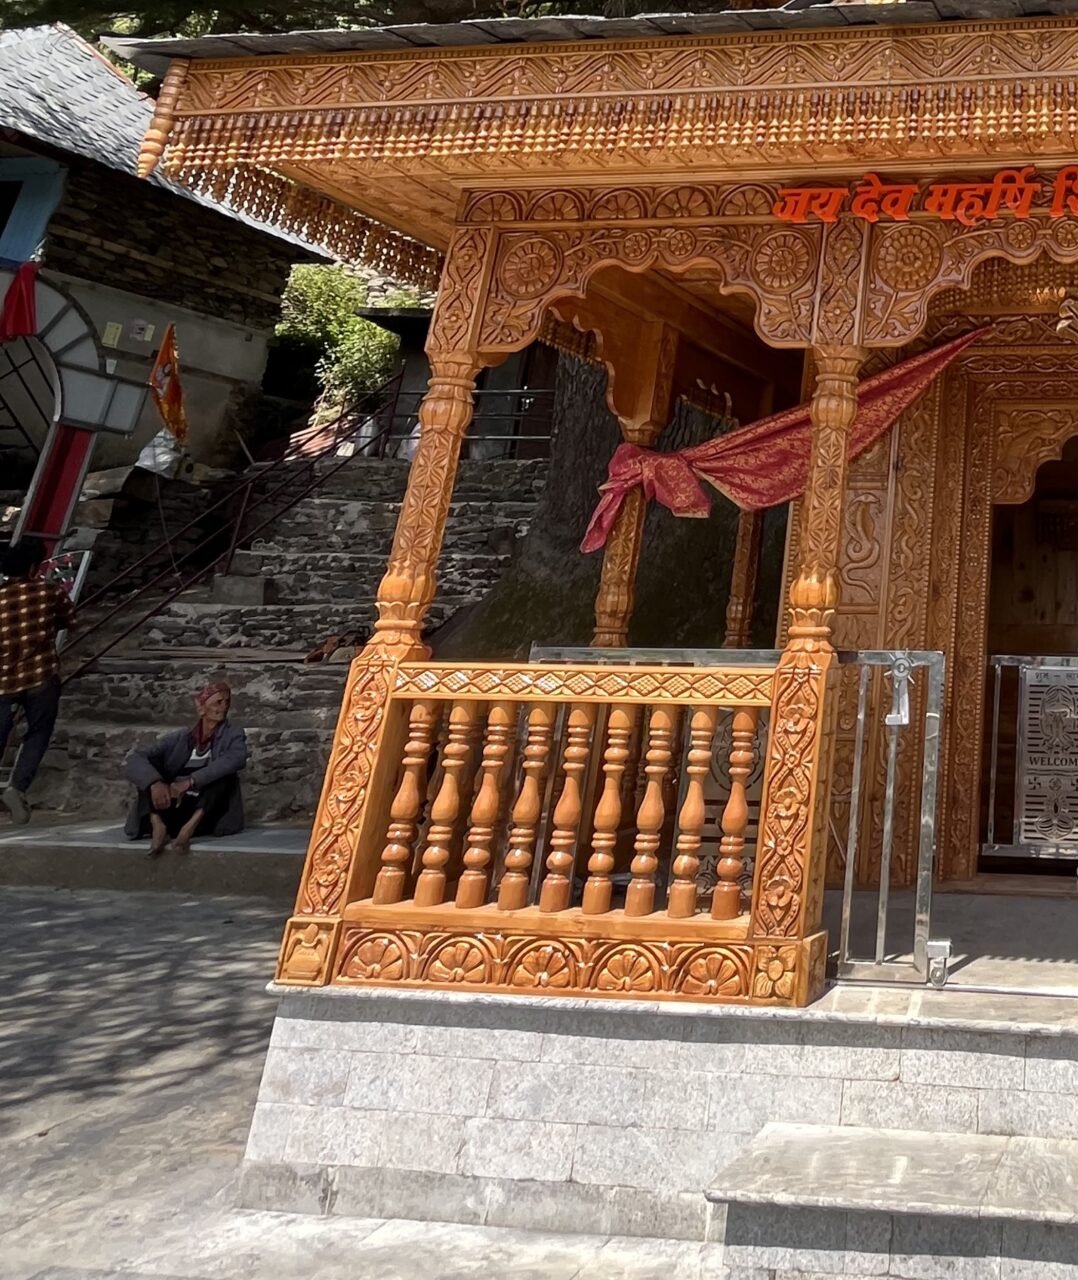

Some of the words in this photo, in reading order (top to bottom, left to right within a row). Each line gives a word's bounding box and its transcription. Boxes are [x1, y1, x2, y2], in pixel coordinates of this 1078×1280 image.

[772, 186, 849, 224] जय
[851, 171, 919, 224] देव
[925, 165, 1041, 227] महर्षि
